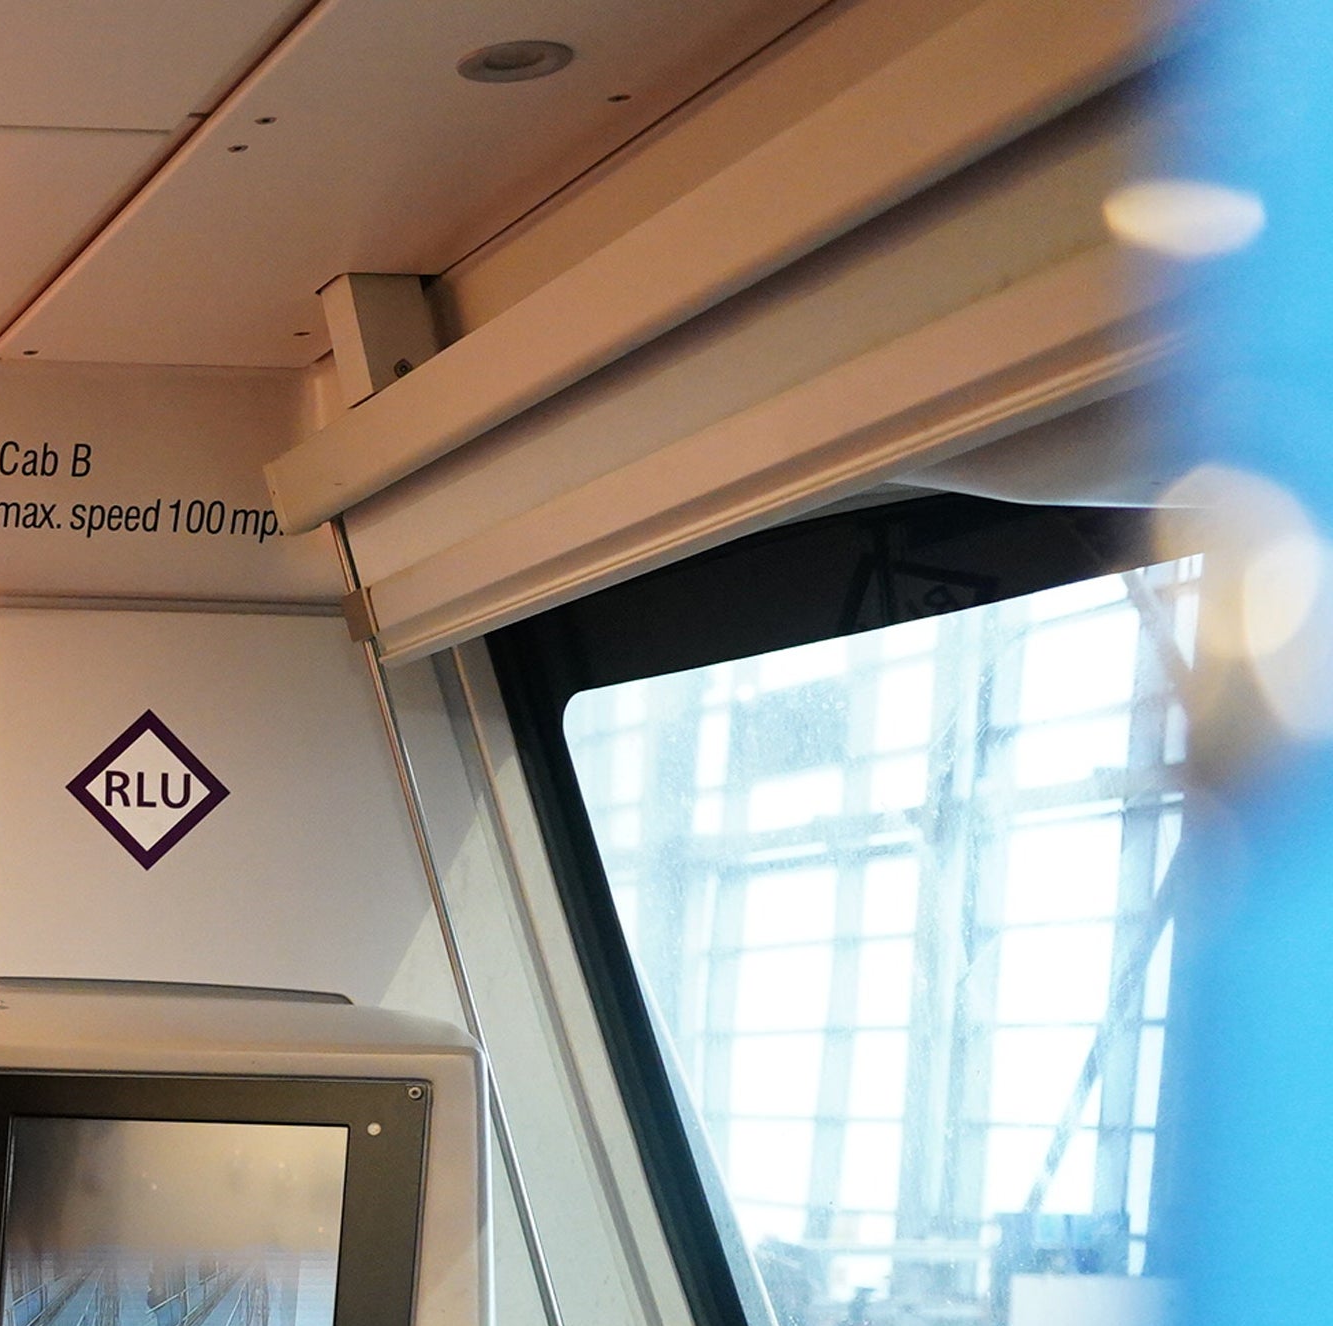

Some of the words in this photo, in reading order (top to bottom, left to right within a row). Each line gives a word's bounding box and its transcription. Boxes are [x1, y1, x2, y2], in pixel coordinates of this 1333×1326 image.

[71, 443, 92, 477] B
[69, 498, 161, 538] speed
[168, 499, 225, 534] 100
[230, 508, 285, 543] mp
[104, 770, 192, 809] RLU
